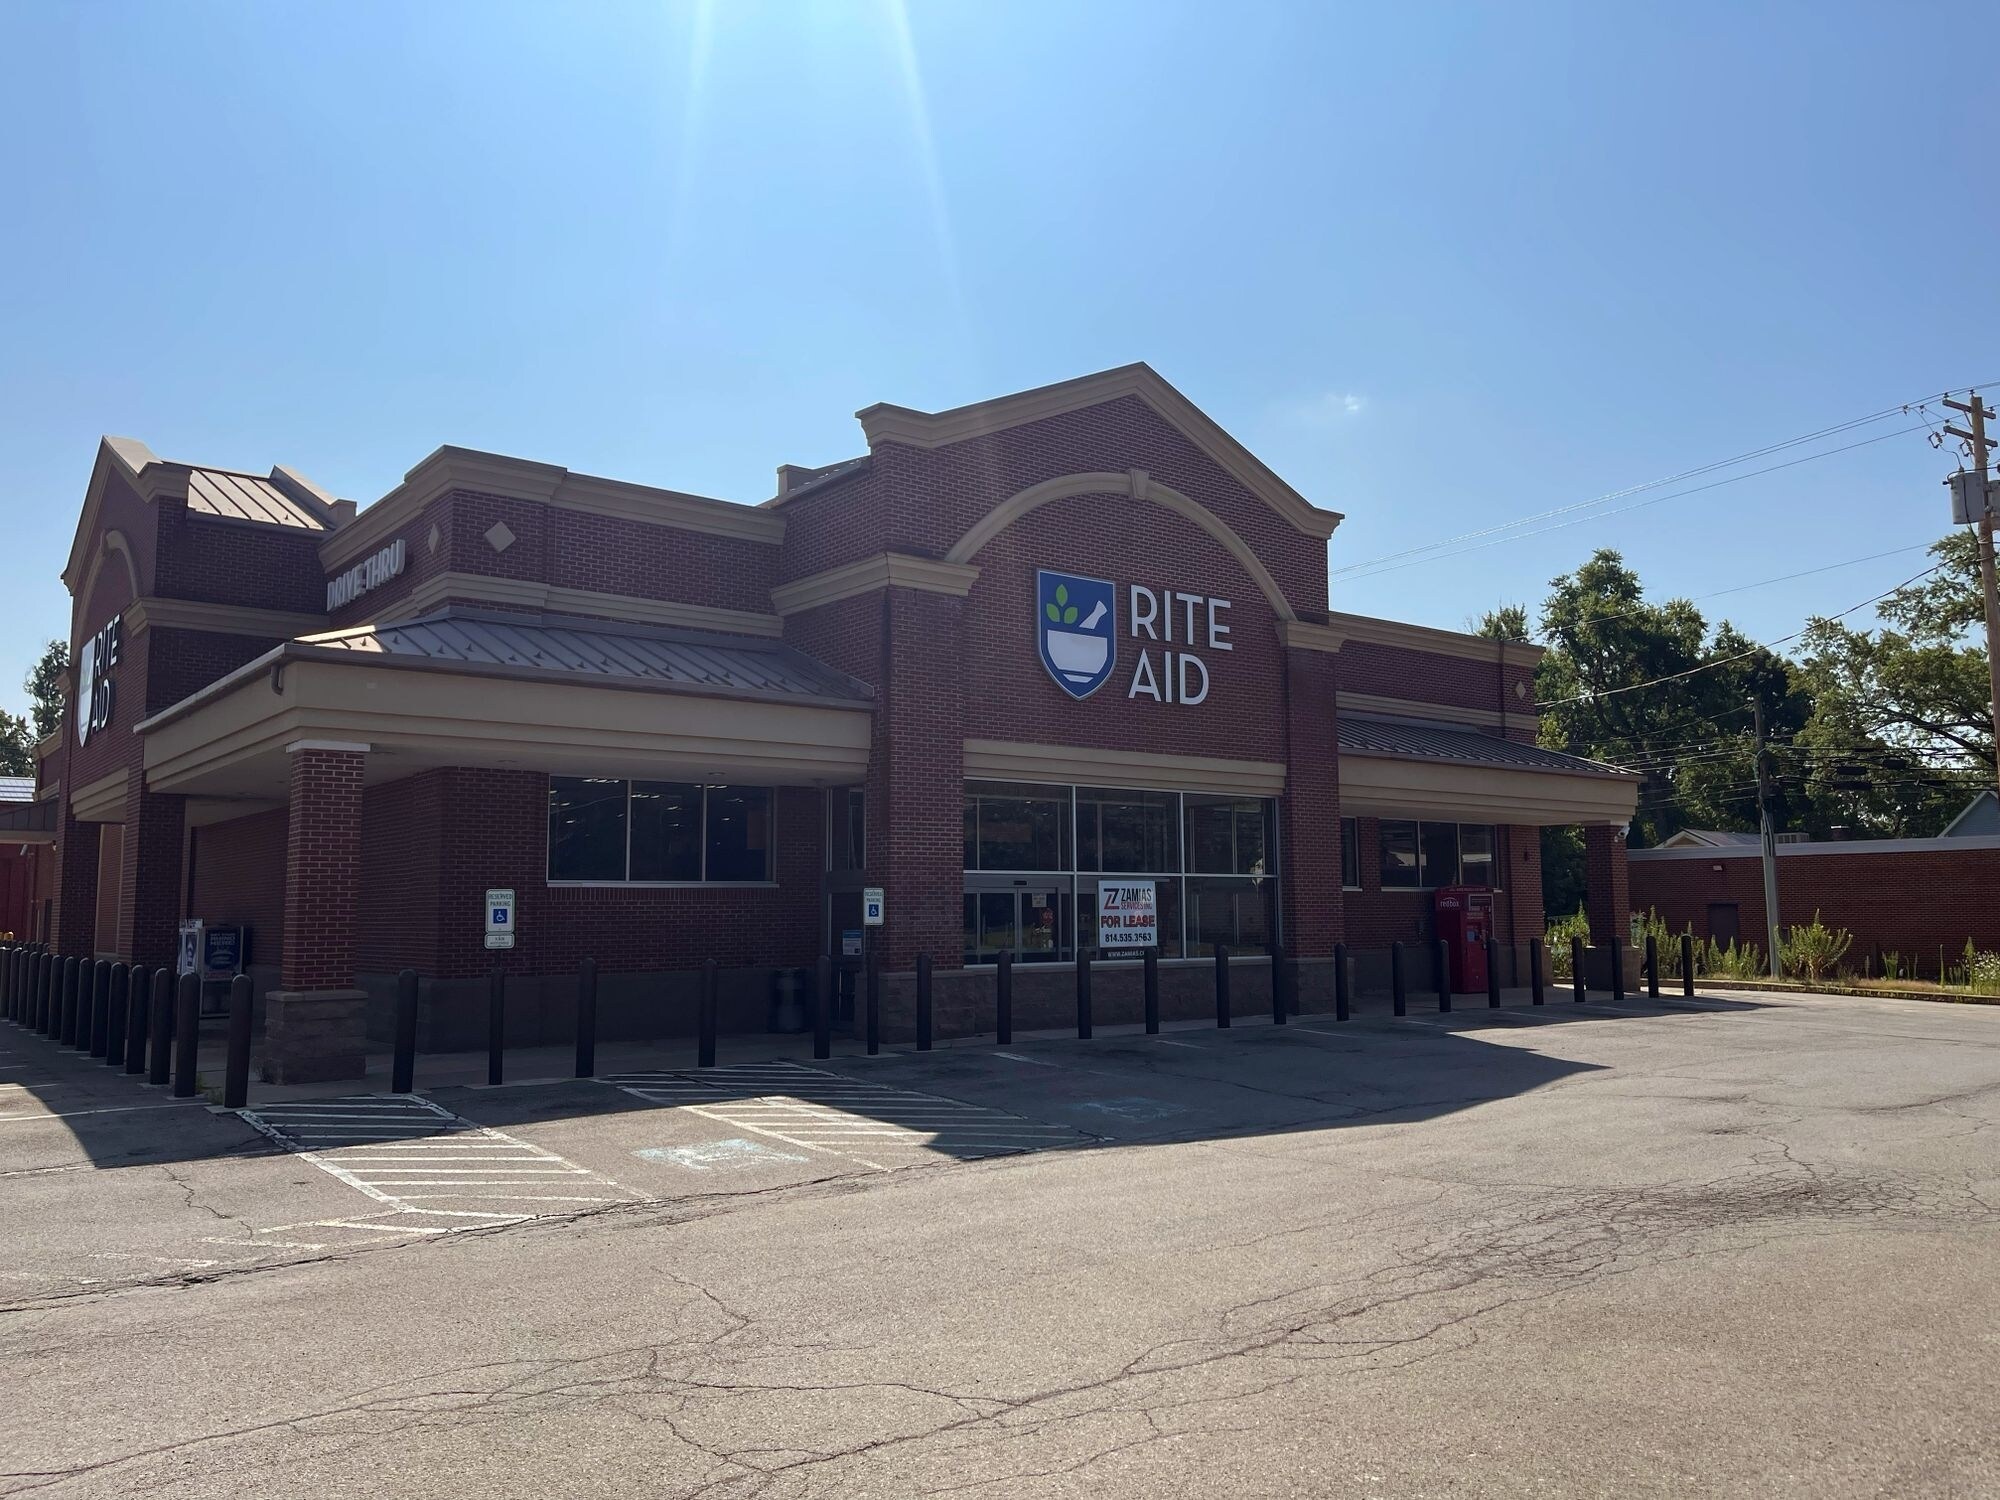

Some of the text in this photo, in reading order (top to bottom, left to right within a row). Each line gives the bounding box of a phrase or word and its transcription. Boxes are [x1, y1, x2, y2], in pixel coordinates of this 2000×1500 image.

[327, 539, 406, 612] DRIVE THRU
[1130, 584, 1233, 651] RITE
[94, 613, 120, 679] RITE
[1128, 648, 1210, 705] AID
[91, 678, 110, 736] AID
[1121, 888, 1152, 901] ZAMIAS
[1121, 901, 1143, 910] SERVICES
[1440, 899, 1459, 908] redbox
[1100, 915, 1155, 928] FOR LEASE
[1105, 933, 1152, 942] 814.535.3563
